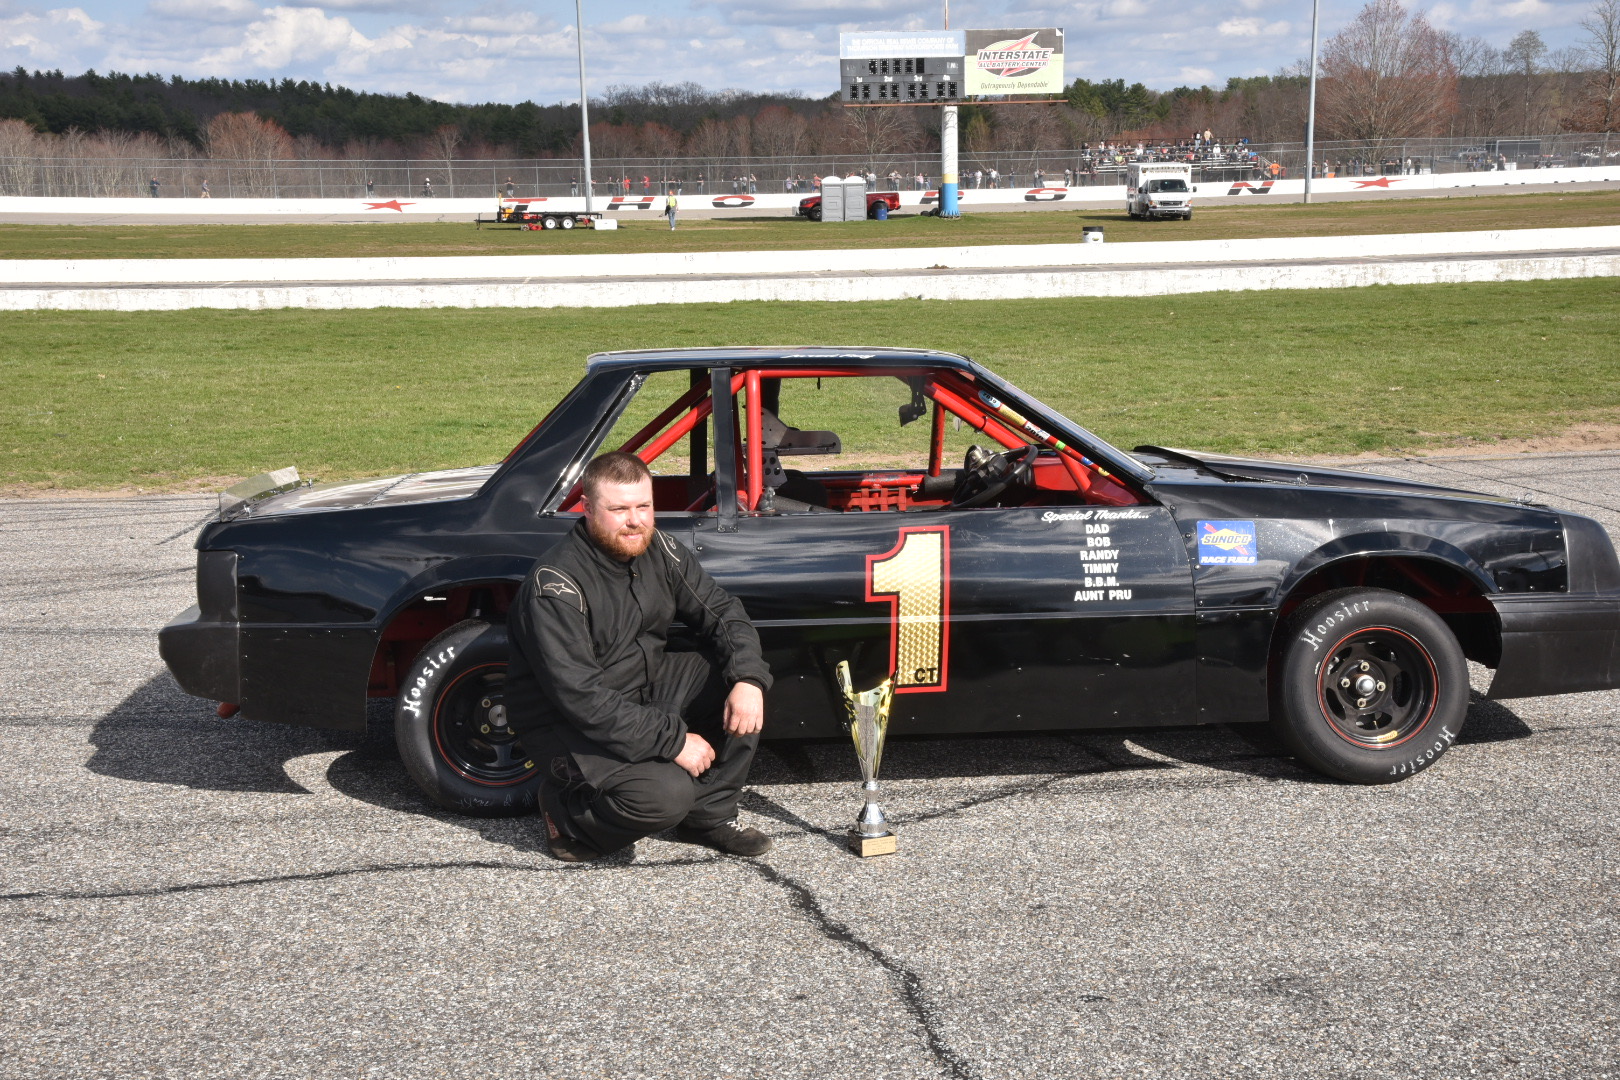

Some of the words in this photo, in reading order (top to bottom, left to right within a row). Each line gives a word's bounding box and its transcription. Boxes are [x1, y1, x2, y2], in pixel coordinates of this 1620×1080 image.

[978, 50, 1049, 60] INTERSTATE
[980, 82, 1016, 90] Outrageously
[1017, 81, 1048, 89] Dependable
[1041, 510, 1093, 523] Special
[1094, 509, 1150, 520] Thanks...
[1086, 524, 1110, 534] DAD
[1087, 537, 1111, 547] BOB
[1204, 534, 1250, 545] SUNOCO
[1080, 549, 1119, 561] RANDY
[1201, 556, 1226, 564] RACE
[1228, 556, 1256, 564] FUELS
[1083, 563, 1119, 574] TIMMY
[1084, 576, 1120, 588] B.B.M.
[1074, 590, 1104, 602] AUNT
[1109, 589, 1132, 600] PRU
[864, 524, 950, 694] 1
[1301, 598, 1370, 652] Hoosier
[914, 667, 937, 682] CT
[403, 644, 456, 718] Hoosier
[1389, 725, 1456, 776] Hoosier
